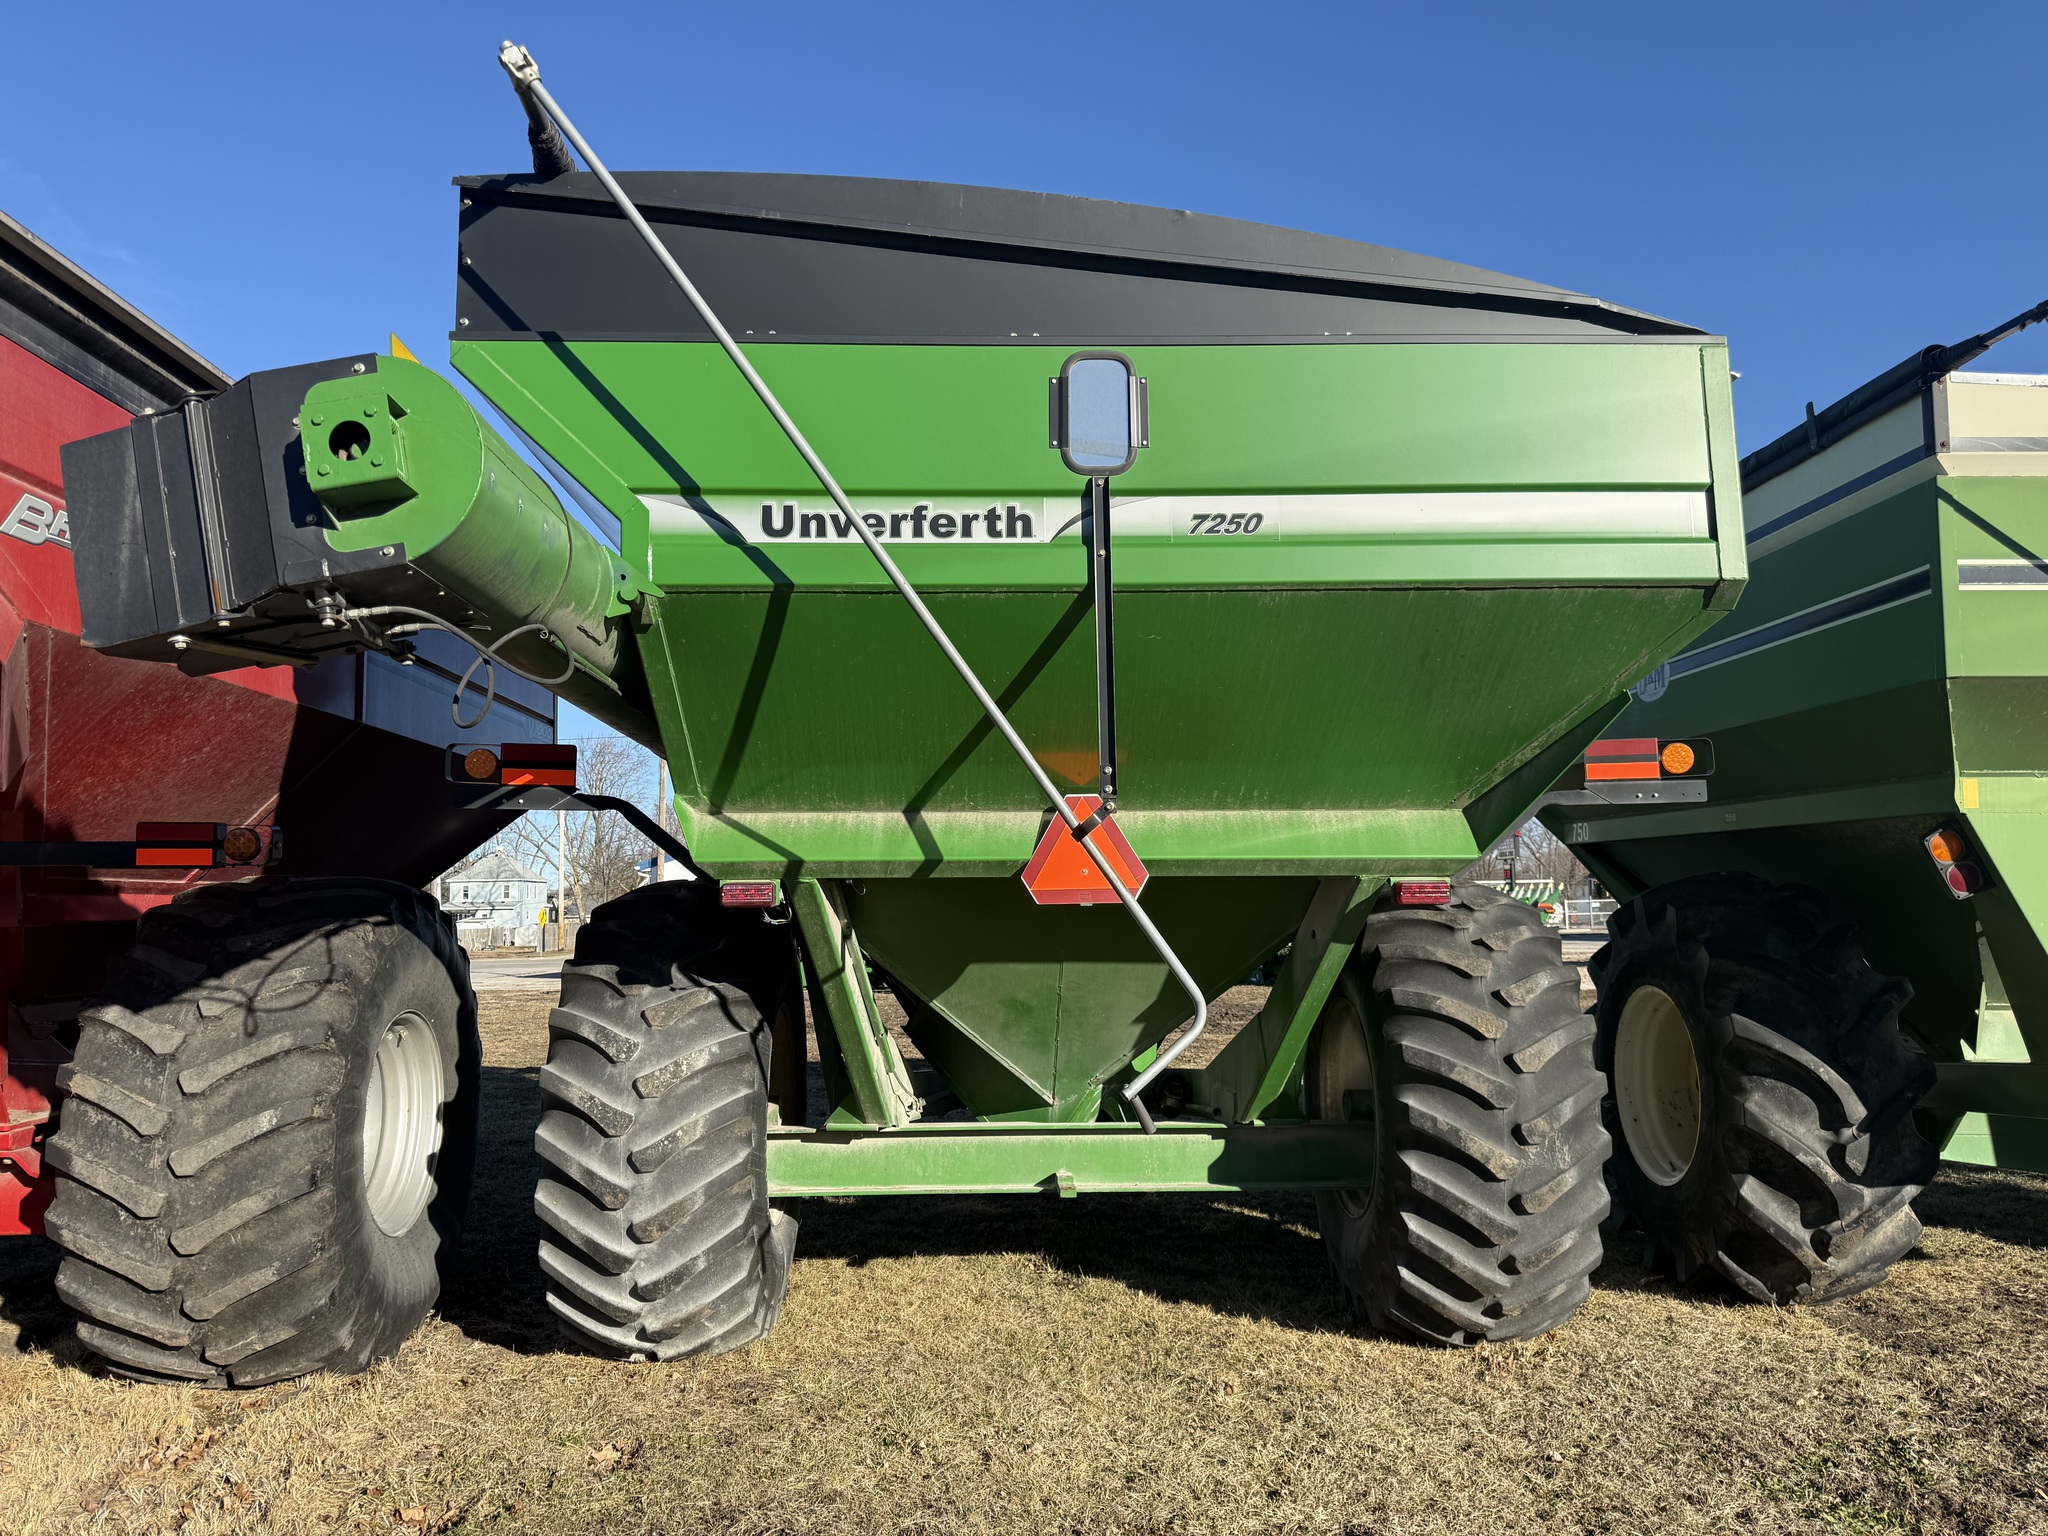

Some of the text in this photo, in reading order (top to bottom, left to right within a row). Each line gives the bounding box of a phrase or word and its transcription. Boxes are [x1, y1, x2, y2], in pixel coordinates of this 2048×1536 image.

[760, 503, 1034, 539] Unverferth
[1188, 512, 1264, 535] 7250
[1572, 822, 1589, 842] 750
